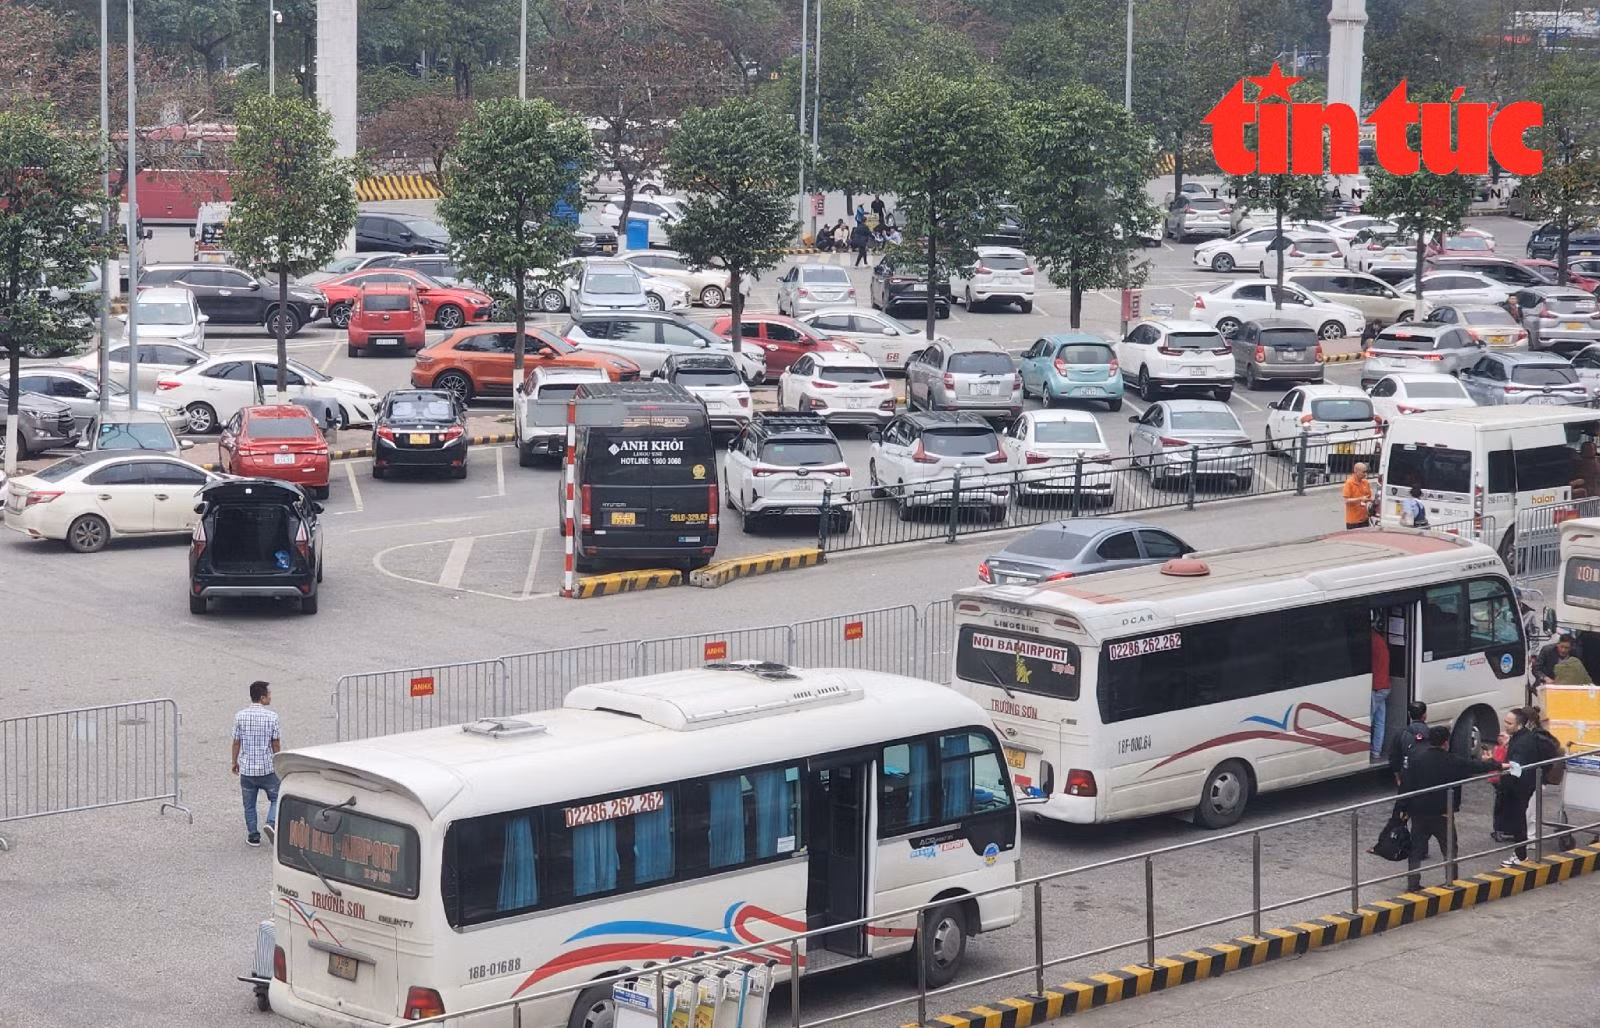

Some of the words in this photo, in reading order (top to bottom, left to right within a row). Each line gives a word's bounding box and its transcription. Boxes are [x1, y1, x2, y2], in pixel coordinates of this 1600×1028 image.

[620, 440, 648, 451] ANH
[651, 438, 684, 451] KHÔI
[620, 457, 651, 465] HOTLINE:
[1122, 613, 1153, 626] DCAR
[1110, 633, 1181, 660] 02286.262.262
[565, 790, 664, 827] 02286.262.262
[469, 957, 521, 979] 18B-01688
